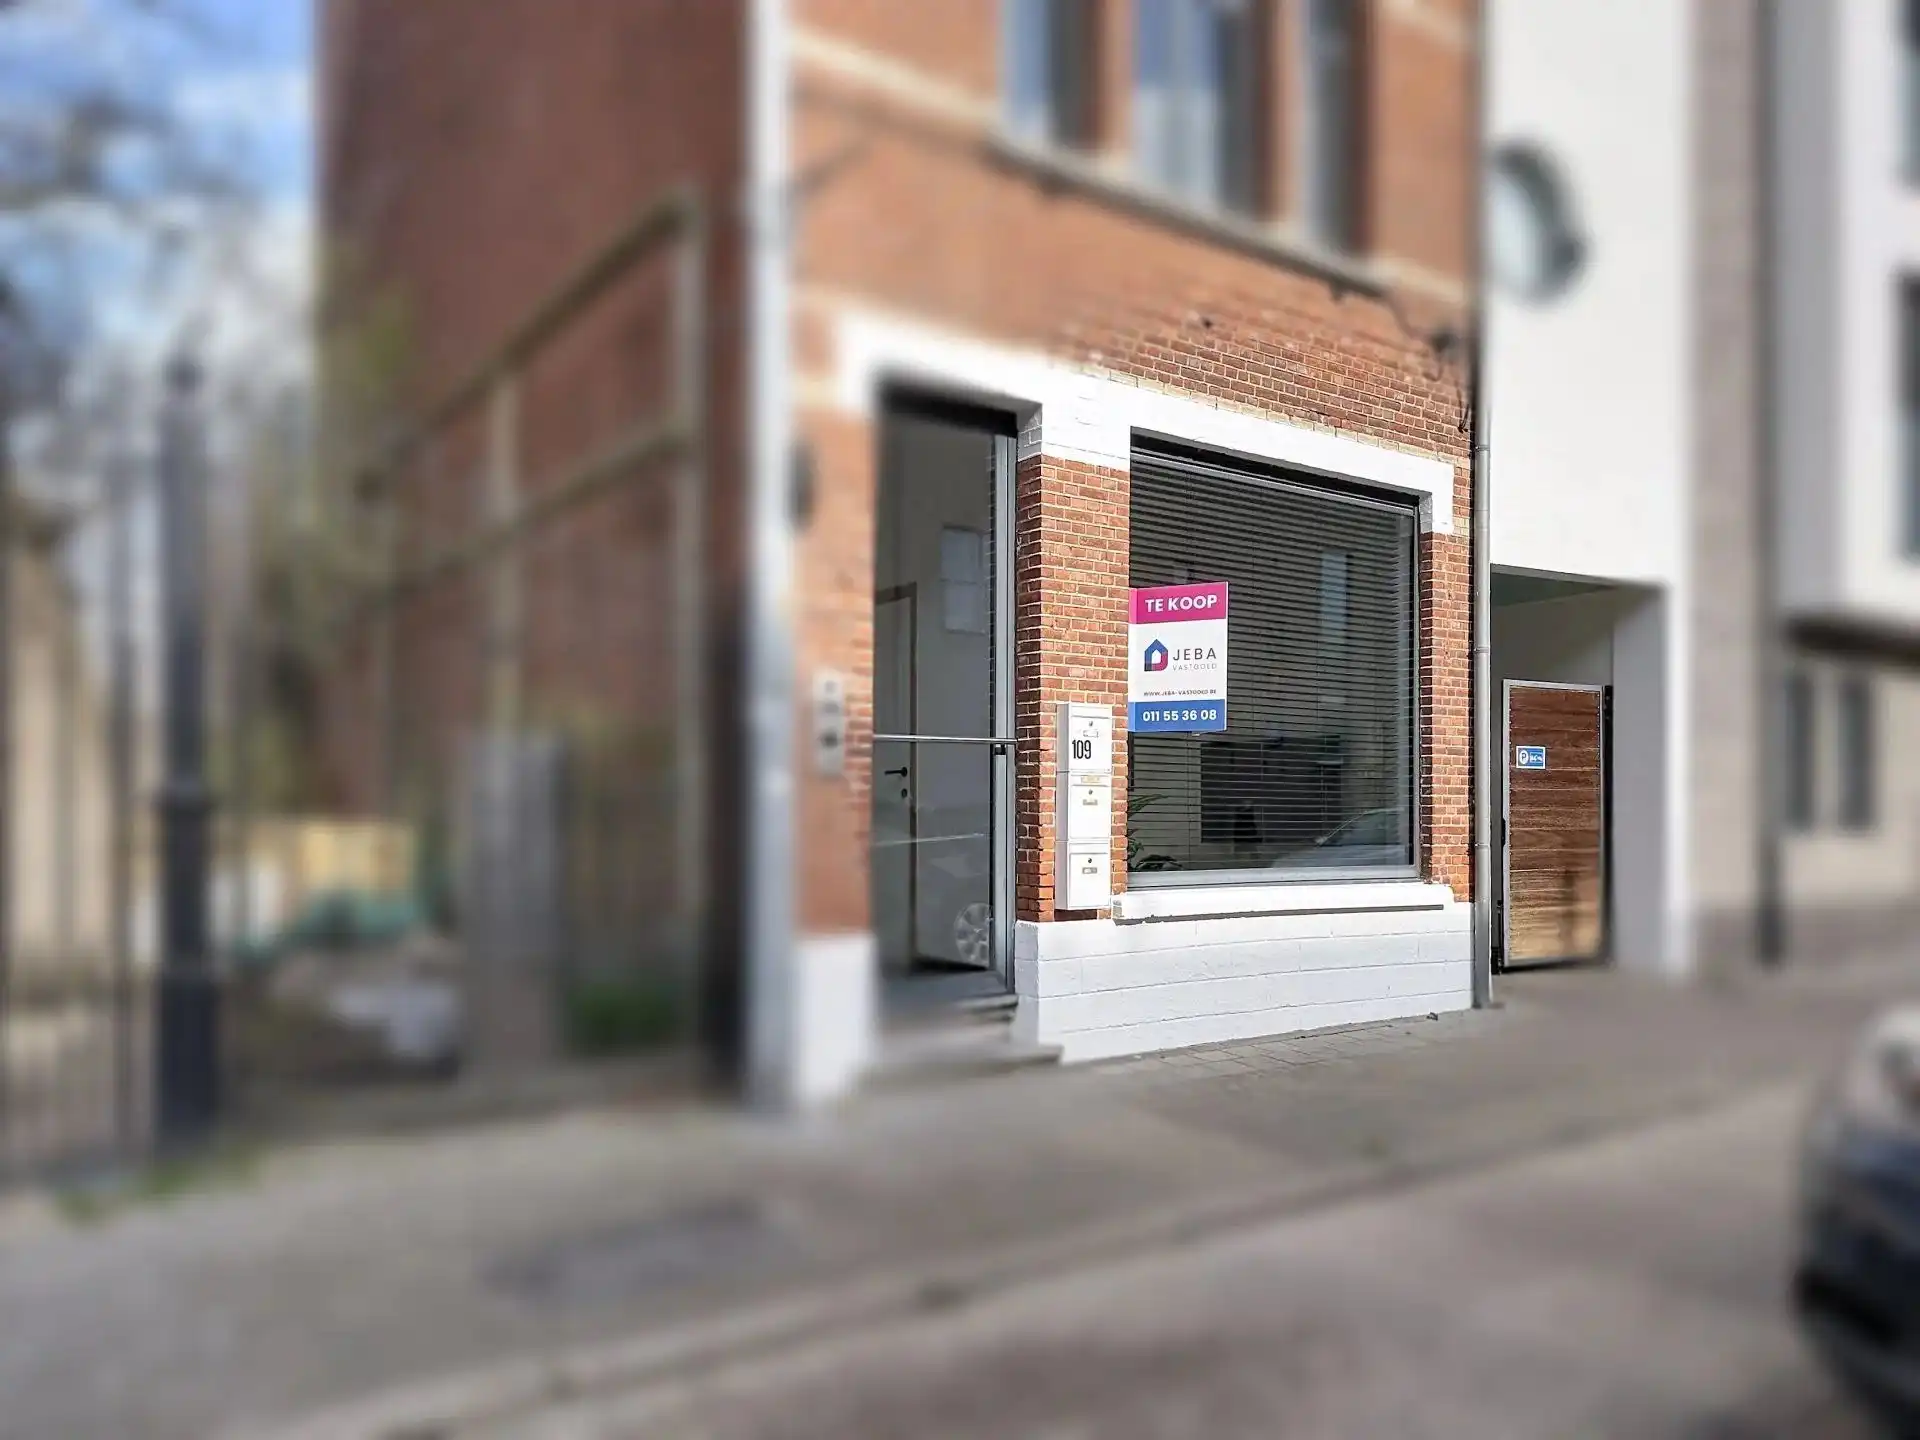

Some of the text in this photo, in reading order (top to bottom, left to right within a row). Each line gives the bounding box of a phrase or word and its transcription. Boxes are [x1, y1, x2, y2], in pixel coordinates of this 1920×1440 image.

[1145, 595, 1218, 613] TE KOOP
[1172, 647, 1217, 661] JEBA
[1173, 663, 1217, 671] VASTGOED
[1142, 709, 1217, 722] 011 55 36 08
[1071, 739, 1092, 760] 109
